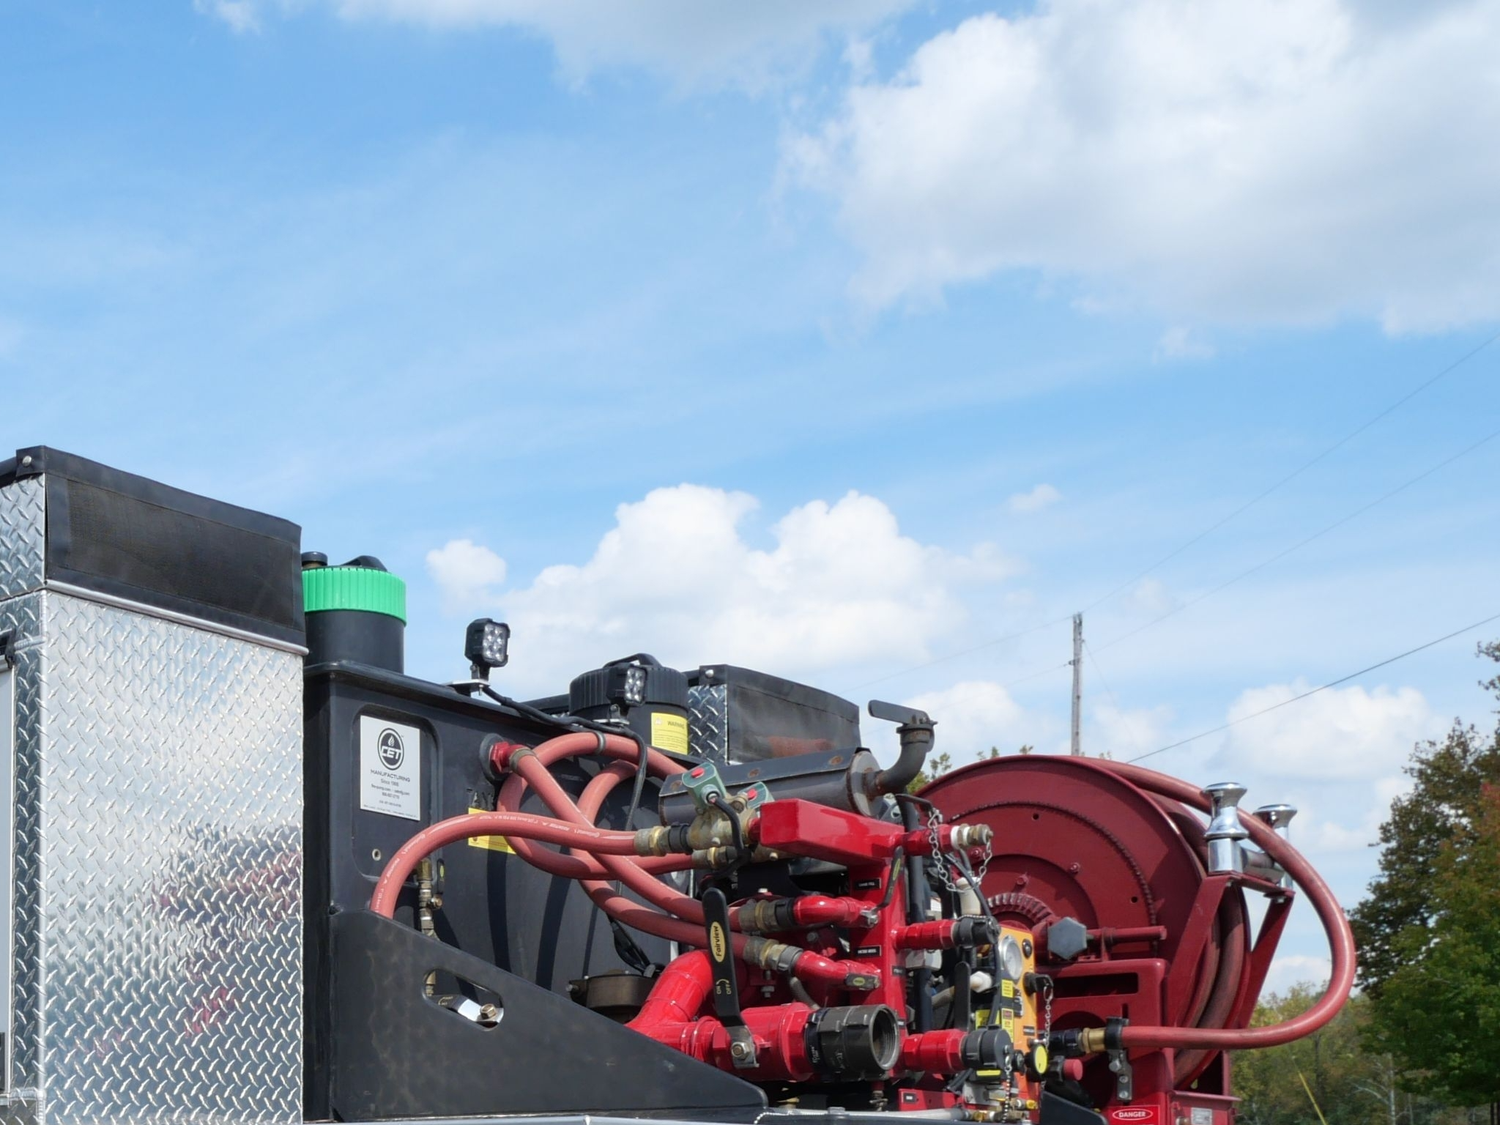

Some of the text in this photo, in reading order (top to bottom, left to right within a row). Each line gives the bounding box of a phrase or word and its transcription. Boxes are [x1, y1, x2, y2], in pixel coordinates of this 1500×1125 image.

[381, 745, 402, 760] CET
[370, 769, 411, 783] MANUFACTURING
[713, 925, 722, 957] Fairview
[716, 985, 722, 995] ON
